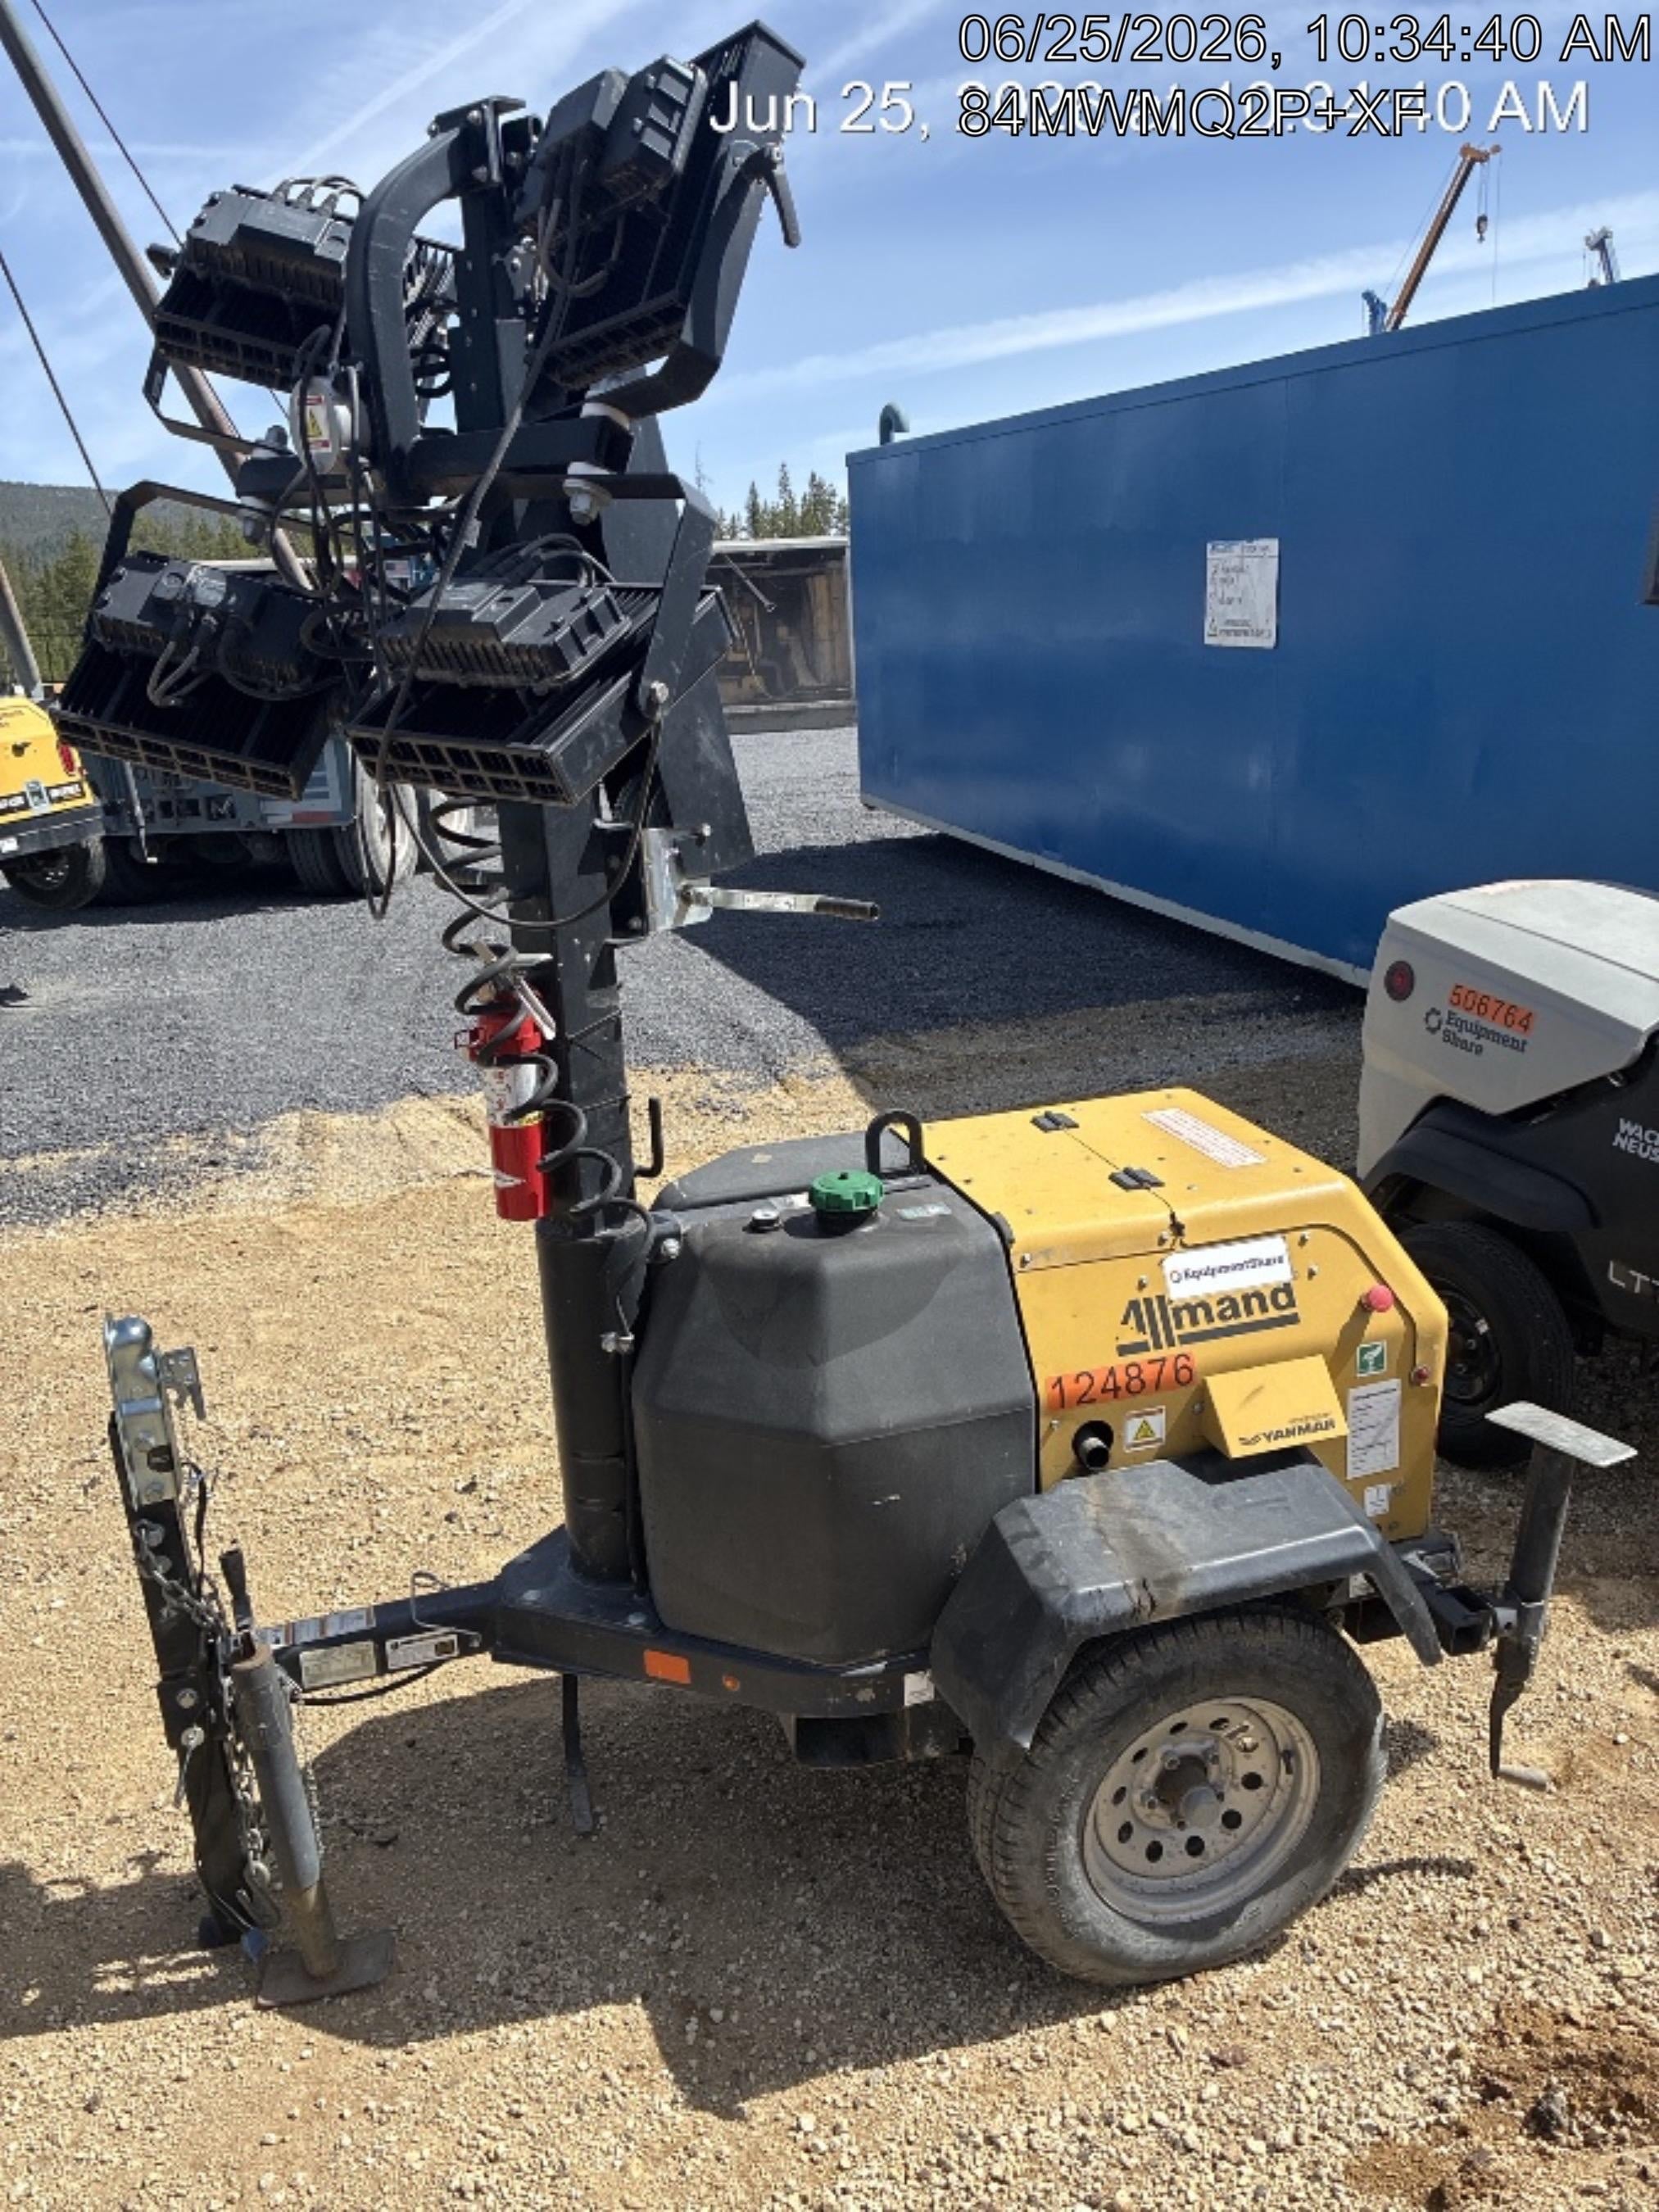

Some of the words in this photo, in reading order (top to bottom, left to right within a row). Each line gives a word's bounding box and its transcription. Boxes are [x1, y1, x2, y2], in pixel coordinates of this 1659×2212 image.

[1449, 984, 1533, 1032] 506764
[1442, 1027, 1484, 1055] Share
[1445, 1009, 1528, 1053] Equipment
[1619, 1117, 1659, 1145] WAC
[1118, 1282, 1297, 1350] Allmand
[1051, 1353, 1194, 1409] 124876
[1262, 1417, 1336, 1443] YANMAR
